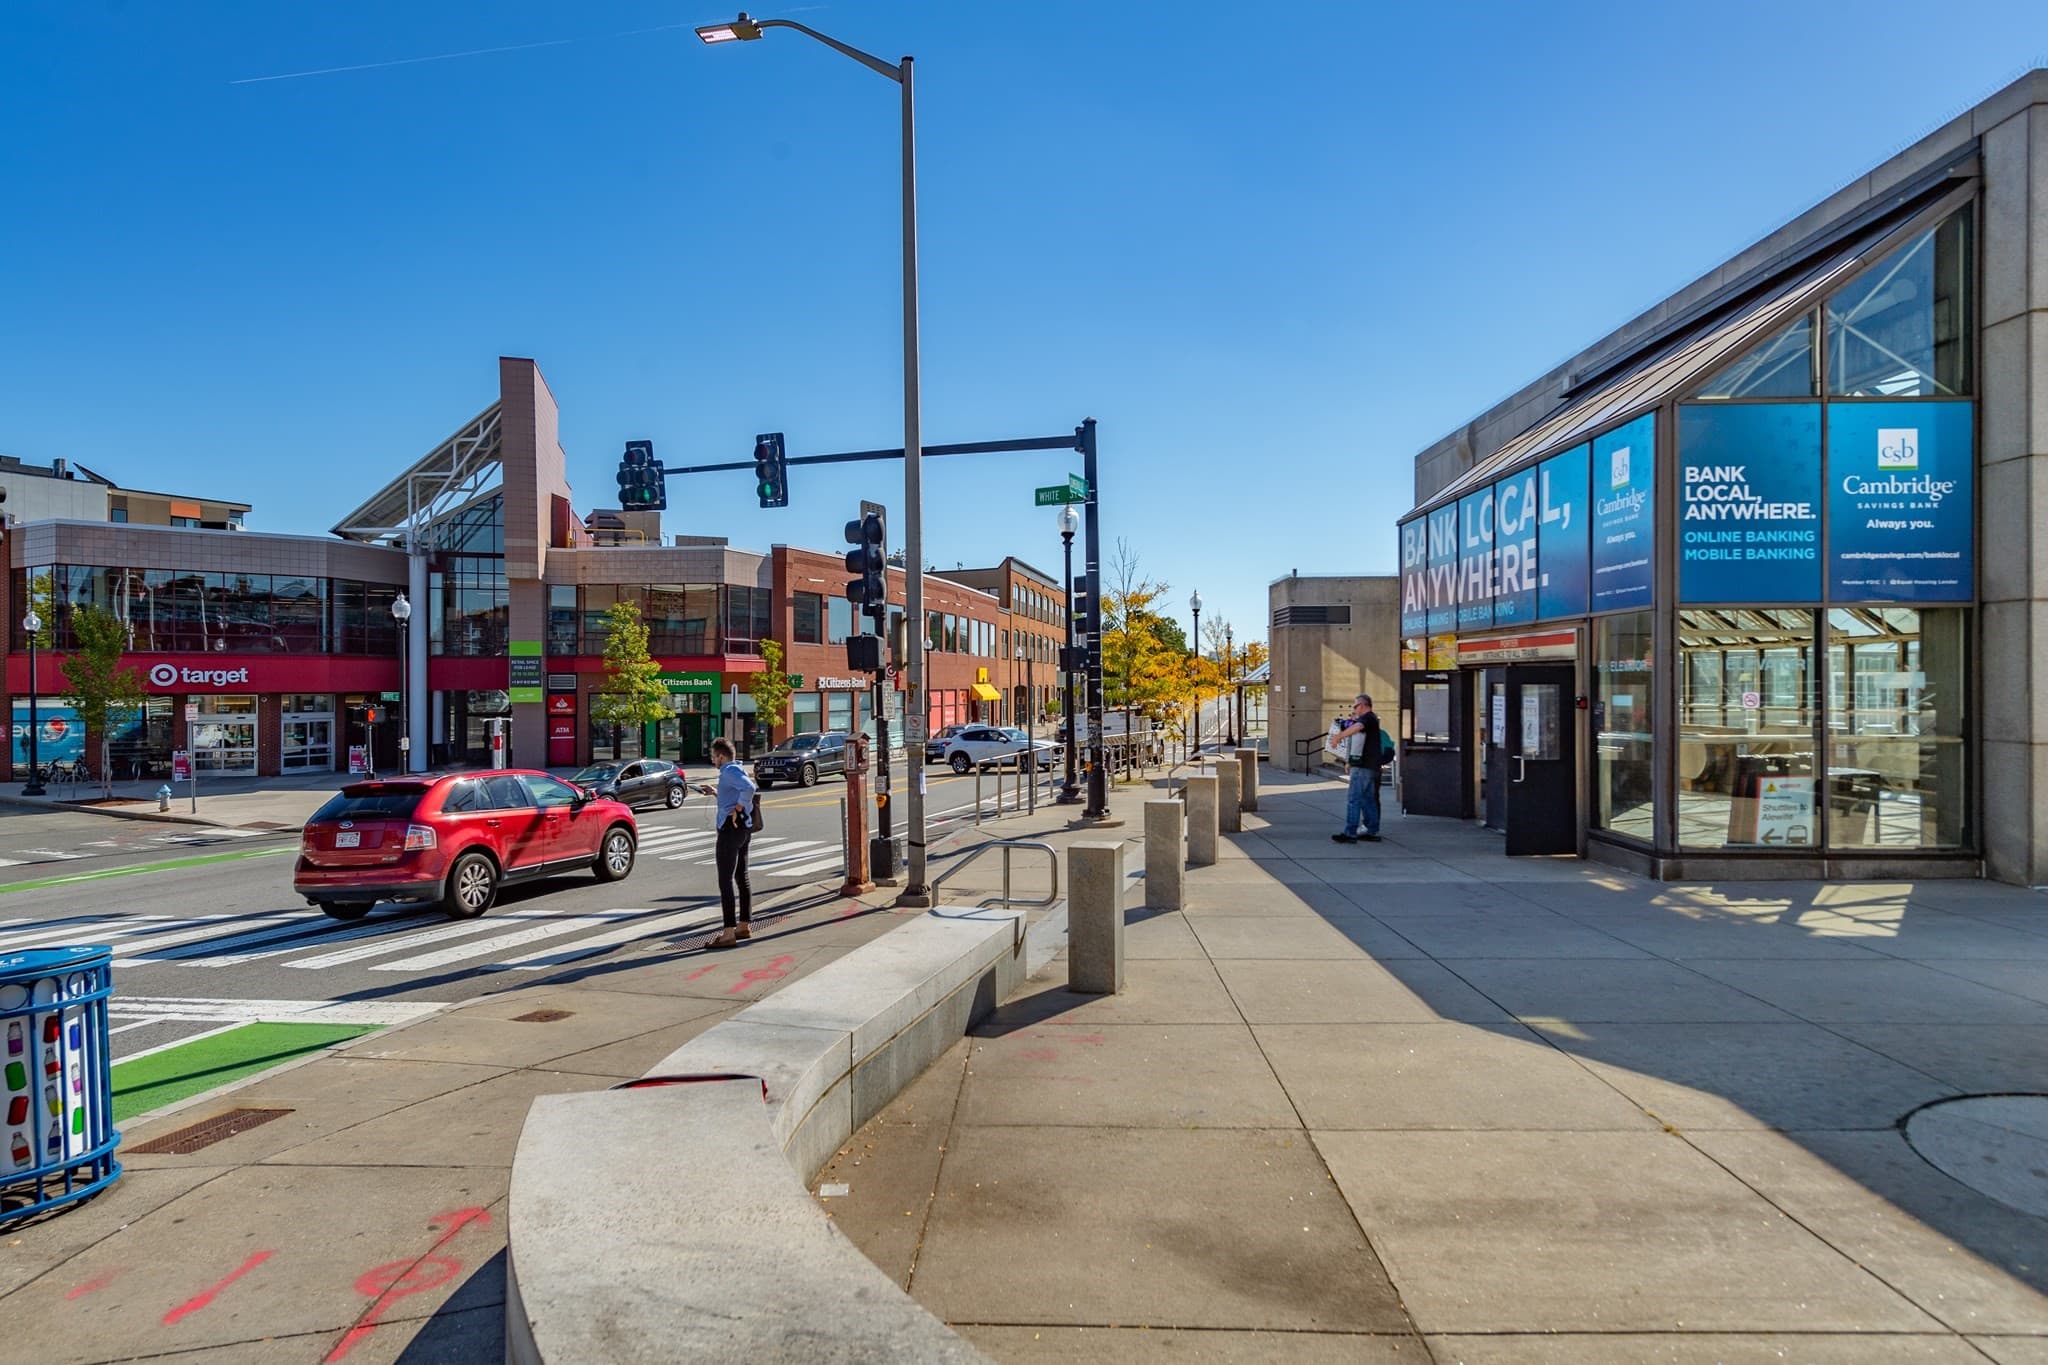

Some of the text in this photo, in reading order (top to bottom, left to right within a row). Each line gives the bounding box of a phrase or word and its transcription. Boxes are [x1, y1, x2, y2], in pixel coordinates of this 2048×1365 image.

[1882, 438, 1914, 462] csb
[1685, 466, 1746, 482] BANK
[1685, 485, 1762, 503] LOCAL,
[1843, 474, 1954, 501] Cambridge
[1039, 490, 1060, 502] WHITE
[1597, 488, 1646, 516] Cambridge
[1405, 470, 1571, 569] BANK LOCAL,
[1684, 503, 1816, 520] ANYWHERE.
[1866, 519, 1935, 530] Always you.
[1684, 530, 1815, 543] ONLINE BANKING
[1684, 548, 1815, 560] MOBILE BANKING
[1404, 537, 1550, 614] ANYWHERE.
[181, 667, 249, 687] target
[662, 678, 713, 686] Citizens Bank
[826, 676, 866, 688] Citizens Bank
[1762, 804, 1798, 812] Shuttles
